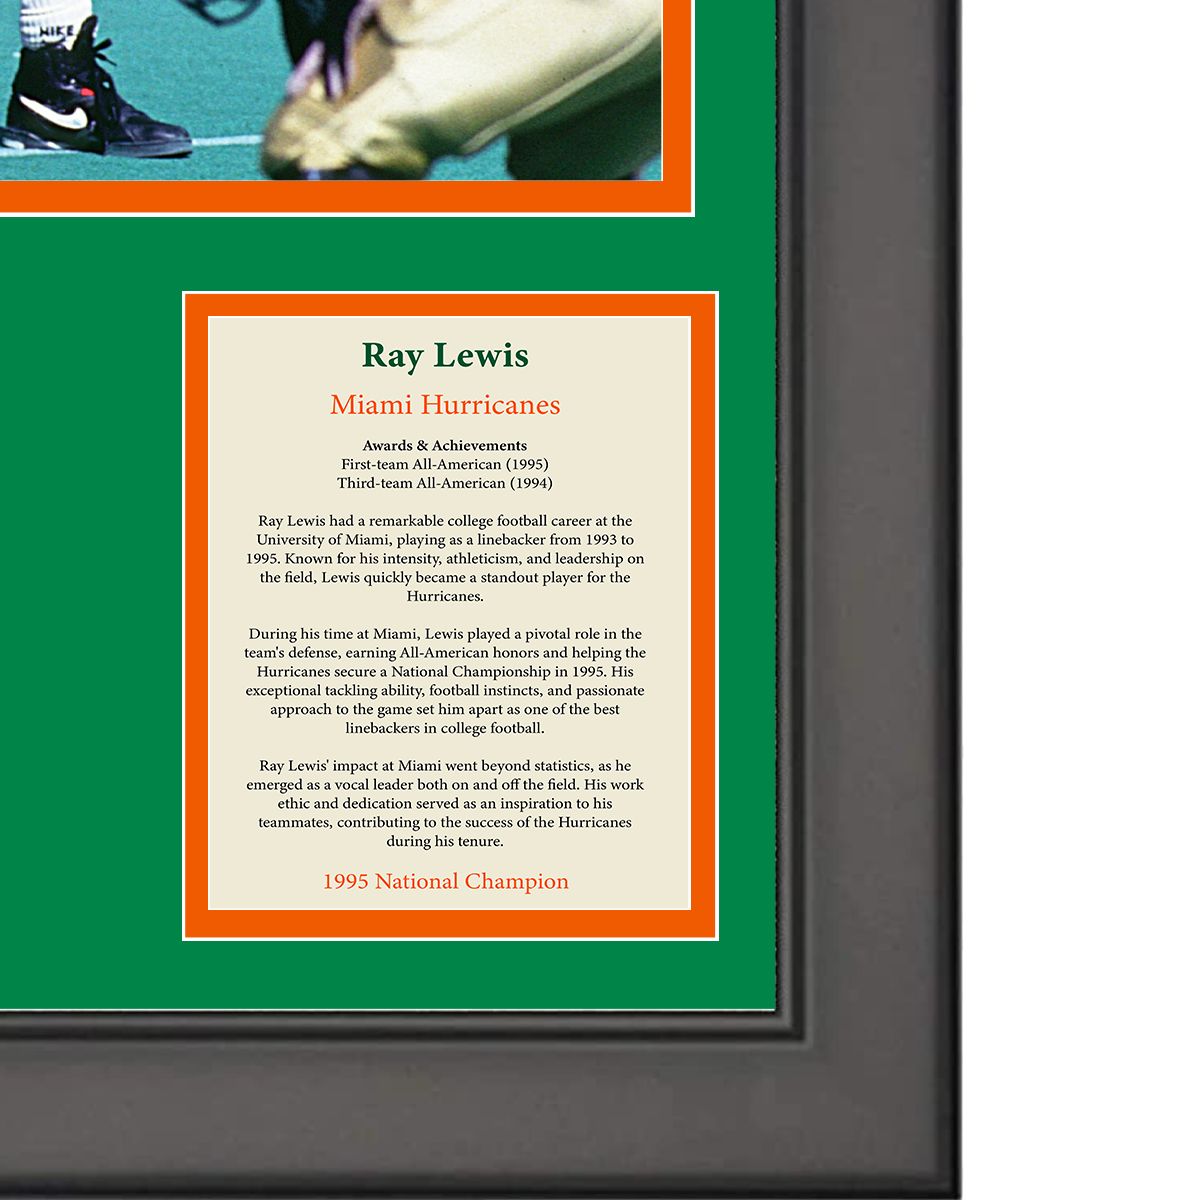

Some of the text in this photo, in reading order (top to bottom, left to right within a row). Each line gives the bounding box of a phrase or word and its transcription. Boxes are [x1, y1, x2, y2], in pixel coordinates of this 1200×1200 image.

[39, 24, 74, 37] NIKE
[361, 341, 529, 377] Ray Lewis
[329, 393, 561, 415] Miami Hurricanes
[362, 438, 528, 452] Awards & Achievements
[341, 457, 549, 473] First-team All-American (1995)
[336, 476, 553, 492] Third-team All-American (1994)
[258, 513, 633, 531] Ray Lewis had a remarkable college football career at the
[256, 532, 635, 550] University of Miami, playing as a linebacker from 1993 to
[246, 551, 645, 569] 1995. Known for his intensity, athleticism, and leadership on
[259, 570, 631, 587] the field, Lewis quickly became a standout player for the
[406, 590, 484, 603] Hurricanes.
[248, 627, 643, 644] During his time at Miami, Lewis played a pivotal role in the
[244, 645, 647, 663] team's defense, earning All-American honors and helping the
[256, 664, 634, 682] Hurricanes secure a National Championship in 1995. His
[245, 683, 645, 701] exceptional tackling ability, football instincts, and passionate
[270, 702, 621, 719] approach to the game set him apart as one of the best
[345, 721, 545, 738] linebackers in college football.
[259, 758, 632, 776] Ray Lewis' impact at Miami went beyond statistics, as he
[246, 777, 645, 795] emerged as a vocal leader both on and off the field. His work
[277, 796, 613, 813] ethic and dedication served as an inspiration to his
[258, 815, 633, 832] teammates, contributing to the success of the Hurricanes
[386, 834, 504, 851] during his tenure.
[323, 871, 570, 895] 1995 National Champion
